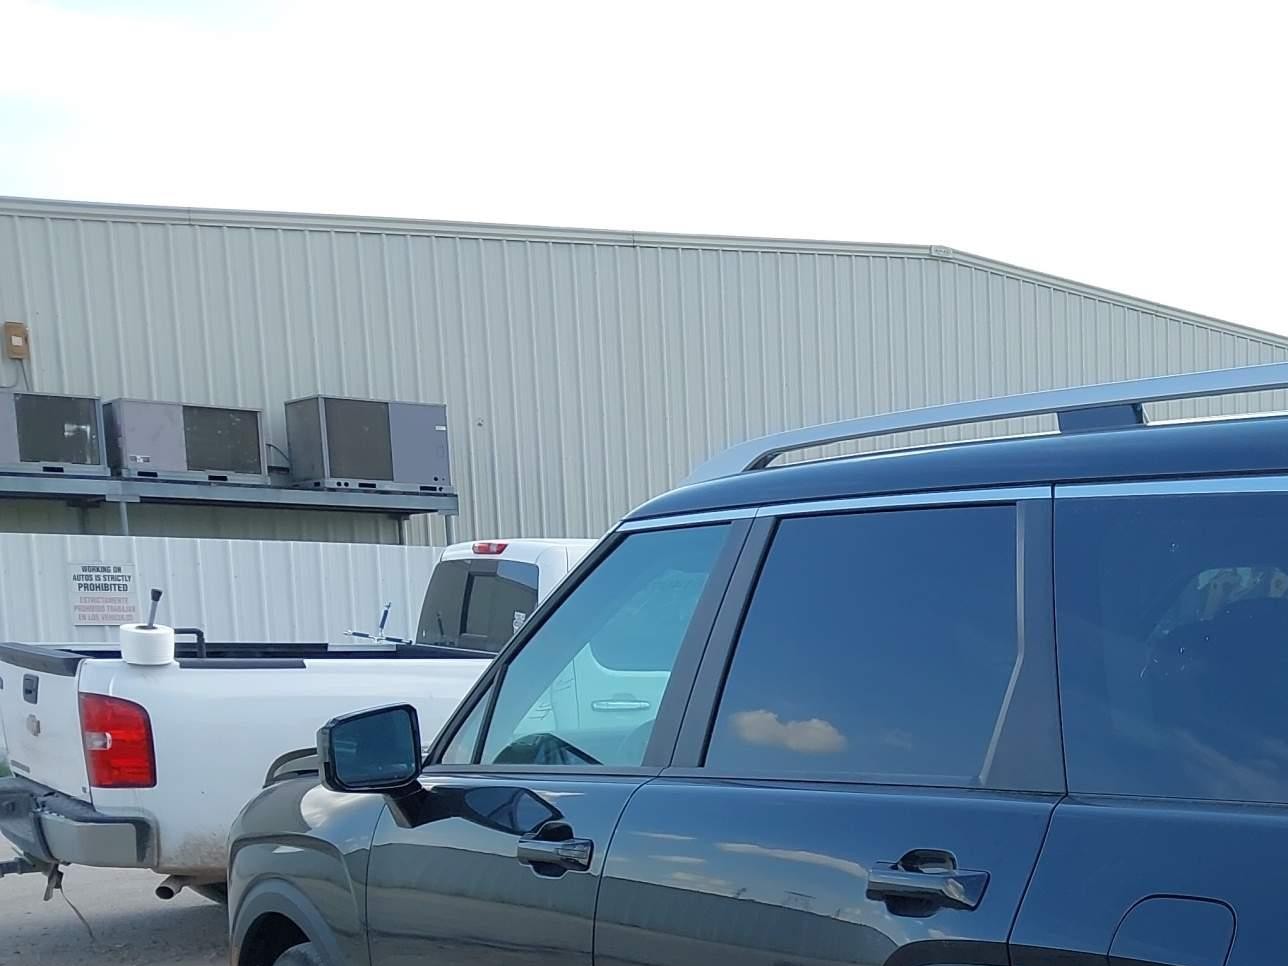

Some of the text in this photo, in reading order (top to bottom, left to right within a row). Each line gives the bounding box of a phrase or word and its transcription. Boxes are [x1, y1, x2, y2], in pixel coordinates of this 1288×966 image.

[73, 574, 93, 582] AUTOS
[103, 575, 132, 583] STRICTLY
[78, 583, 129, 592] PROHIBITED
